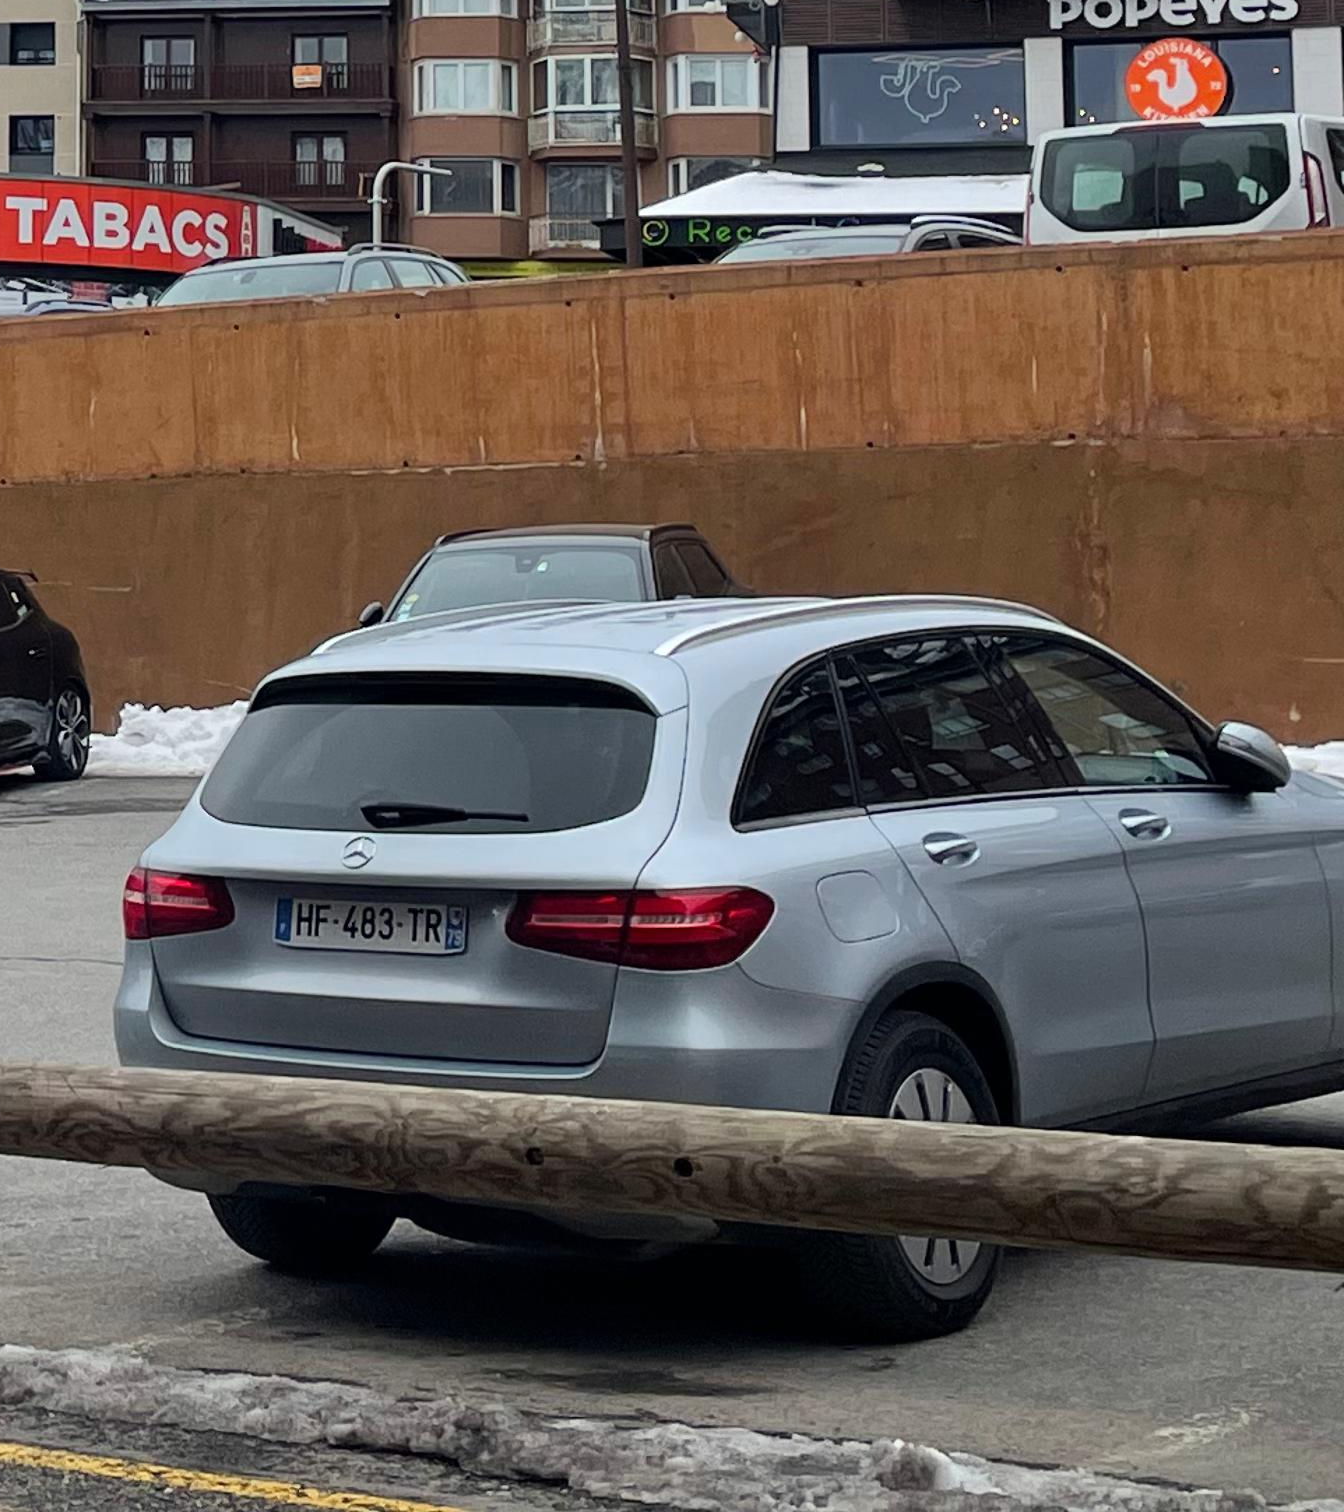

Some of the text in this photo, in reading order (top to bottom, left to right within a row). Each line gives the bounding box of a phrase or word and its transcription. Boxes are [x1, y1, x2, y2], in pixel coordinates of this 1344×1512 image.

[1137, 41, 1213, 68] LOUISIANA
[5, 196, 229, 259] TABACS
[243, 209, 251, 256] TABA
[688, 219, 752, 242] Rec
